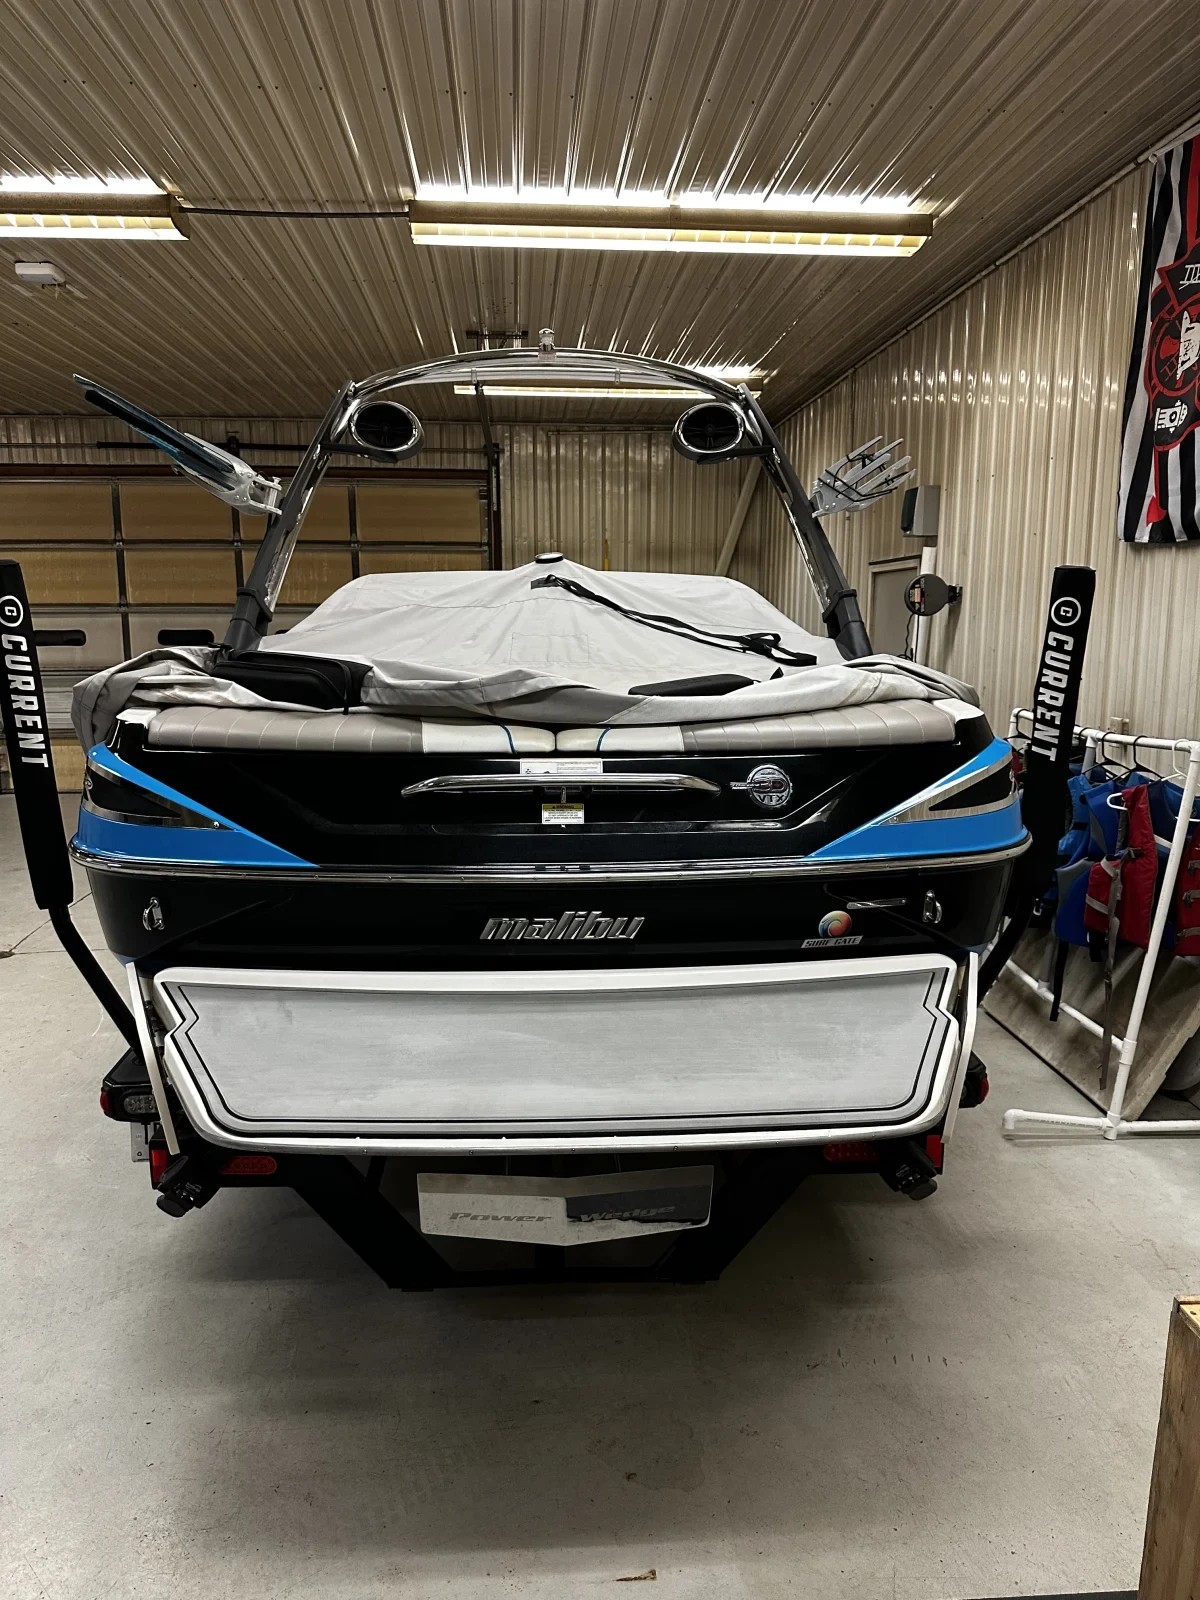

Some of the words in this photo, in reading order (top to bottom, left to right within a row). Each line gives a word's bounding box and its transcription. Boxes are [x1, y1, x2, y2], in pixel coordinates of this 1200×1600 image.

[1, 634, 49, 768] CURRENT
[1031, 631, 1074, 761] CURRENT
[758, 795, 785, 803] VTX
[479, 911, 645, 940] malibu
[805, 939, 831, 947] SURF
[833, 937, 860, 946] GATE
[449, 1211, 553, 1223] Power
[579, 1204, 676, 1222] Wedge
